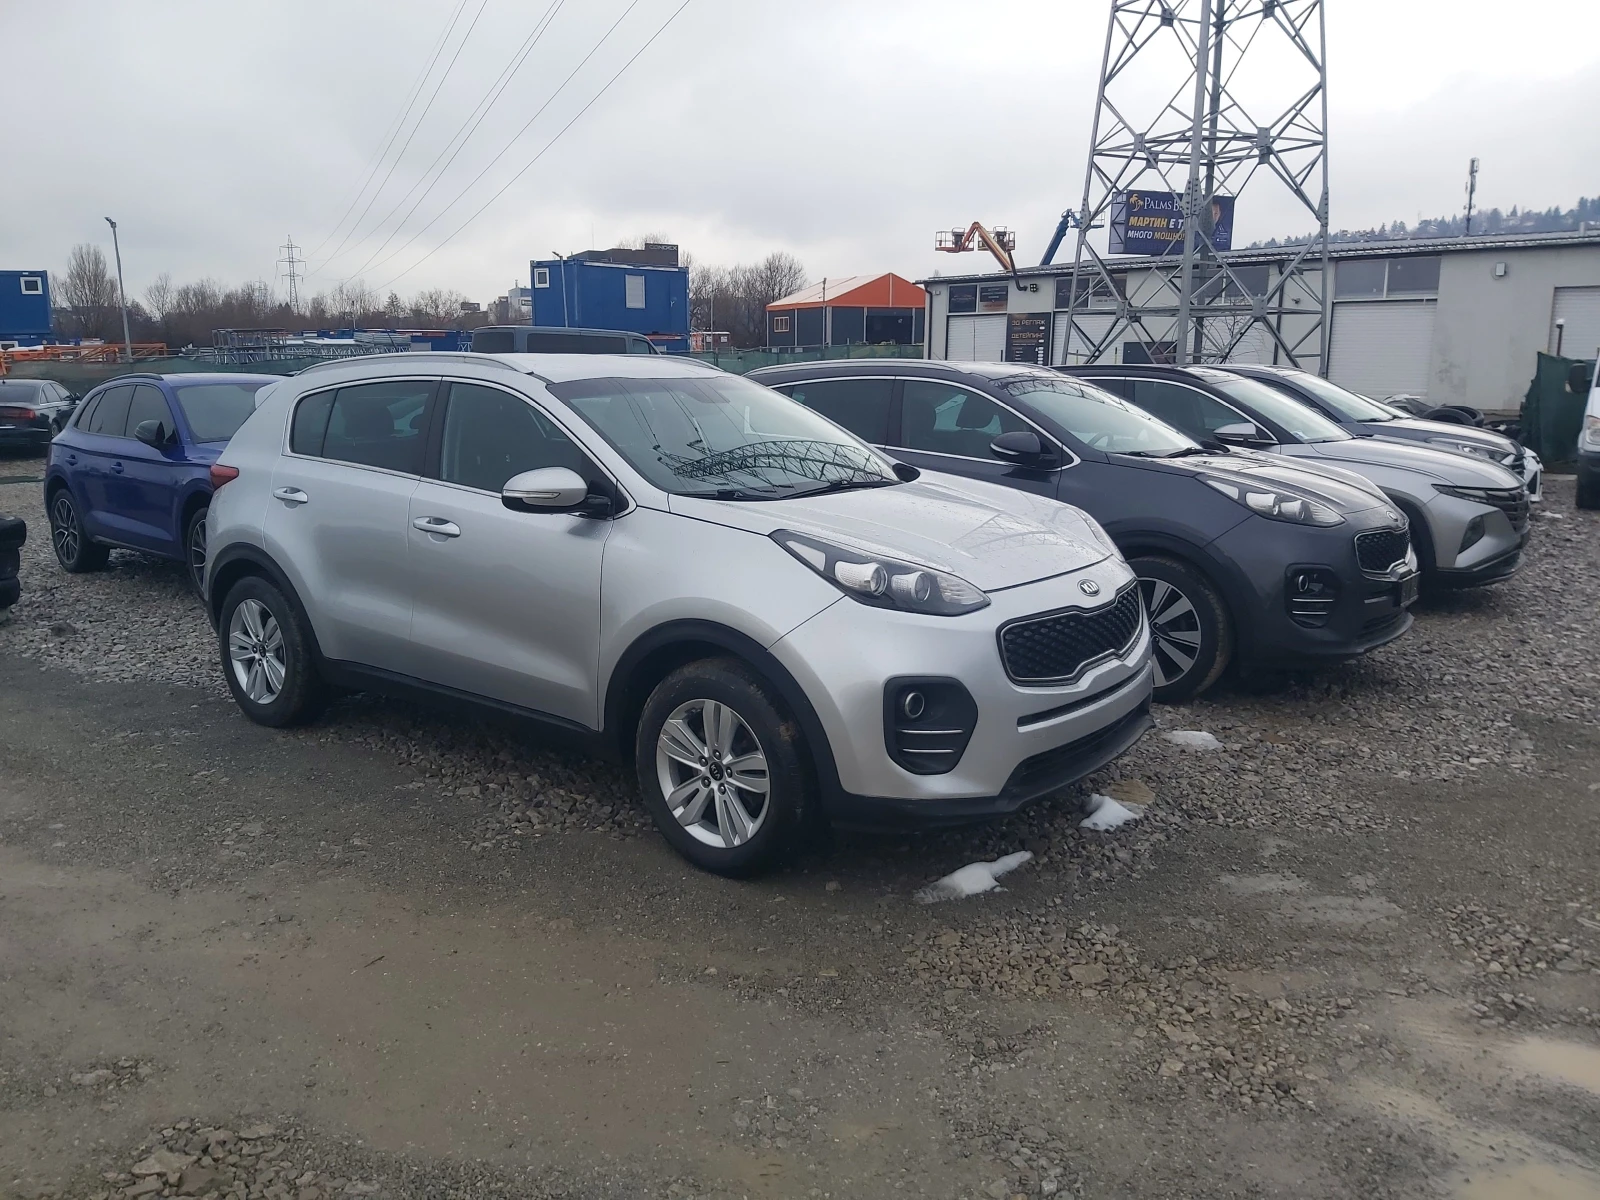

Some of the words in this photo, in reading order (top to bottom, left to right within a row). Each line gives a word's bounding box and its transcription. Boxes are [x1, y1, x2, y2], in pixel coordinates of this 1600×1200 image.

[1144, 197, 1172, 210] PALMS
[1128, 216, 1167, 228] МАРТИН
[1127, 229, 1153, 239] МНОГО
